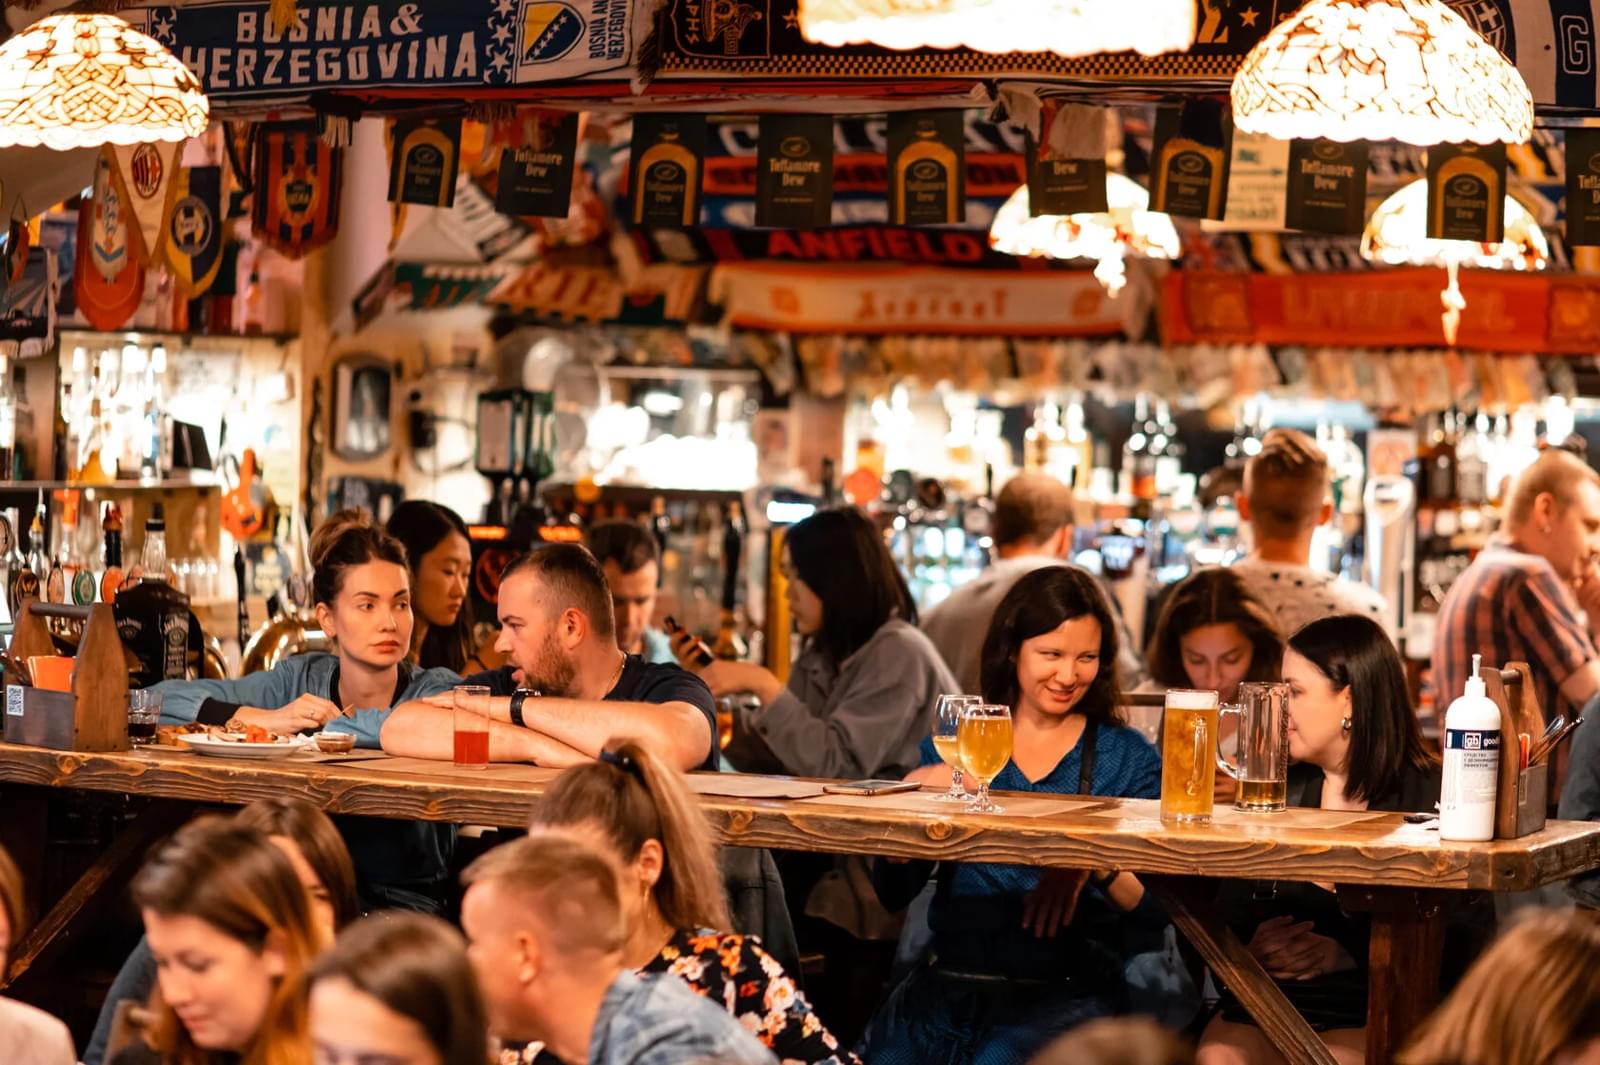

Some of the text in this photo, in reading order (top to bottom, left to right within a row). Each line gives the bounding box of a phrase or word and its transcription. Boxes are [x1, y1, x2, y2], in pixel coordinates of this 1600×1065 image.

[237, 3, 423, 43] BOSNIA &
[589, 17, 607, 59] BOSNIA
[182, 31, 477, 89] HERZEGOVINA
[782, 173, 805, 187] Dew
[1314, 175, 1338, 191] Dew
[767, 229, 983, 262] ANFIELD
